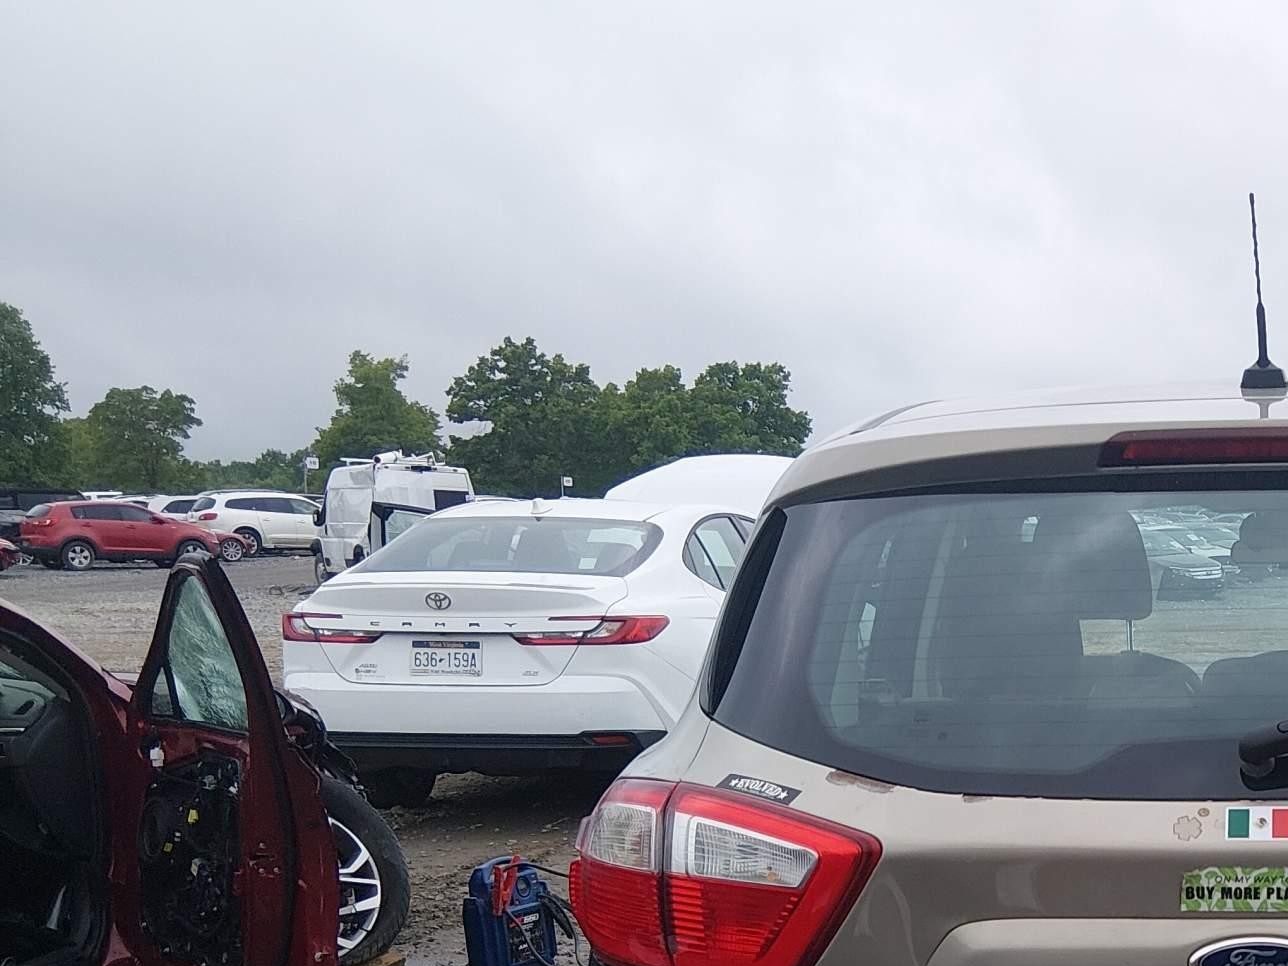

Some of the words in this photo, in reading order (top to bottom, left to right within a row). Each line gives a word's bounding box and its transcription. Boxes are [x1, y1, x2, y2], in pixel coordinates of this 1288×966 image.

[736, 778, 783, 796] EVOLVED
[1215, 875, 1232, 884] ON
[1234, 875, 1251, 884] MY
[1253, 875, 1277, 884] WAY
[1185, 886, 1215, 900] BUY
[1220, 886, 1261, 900] MORE
